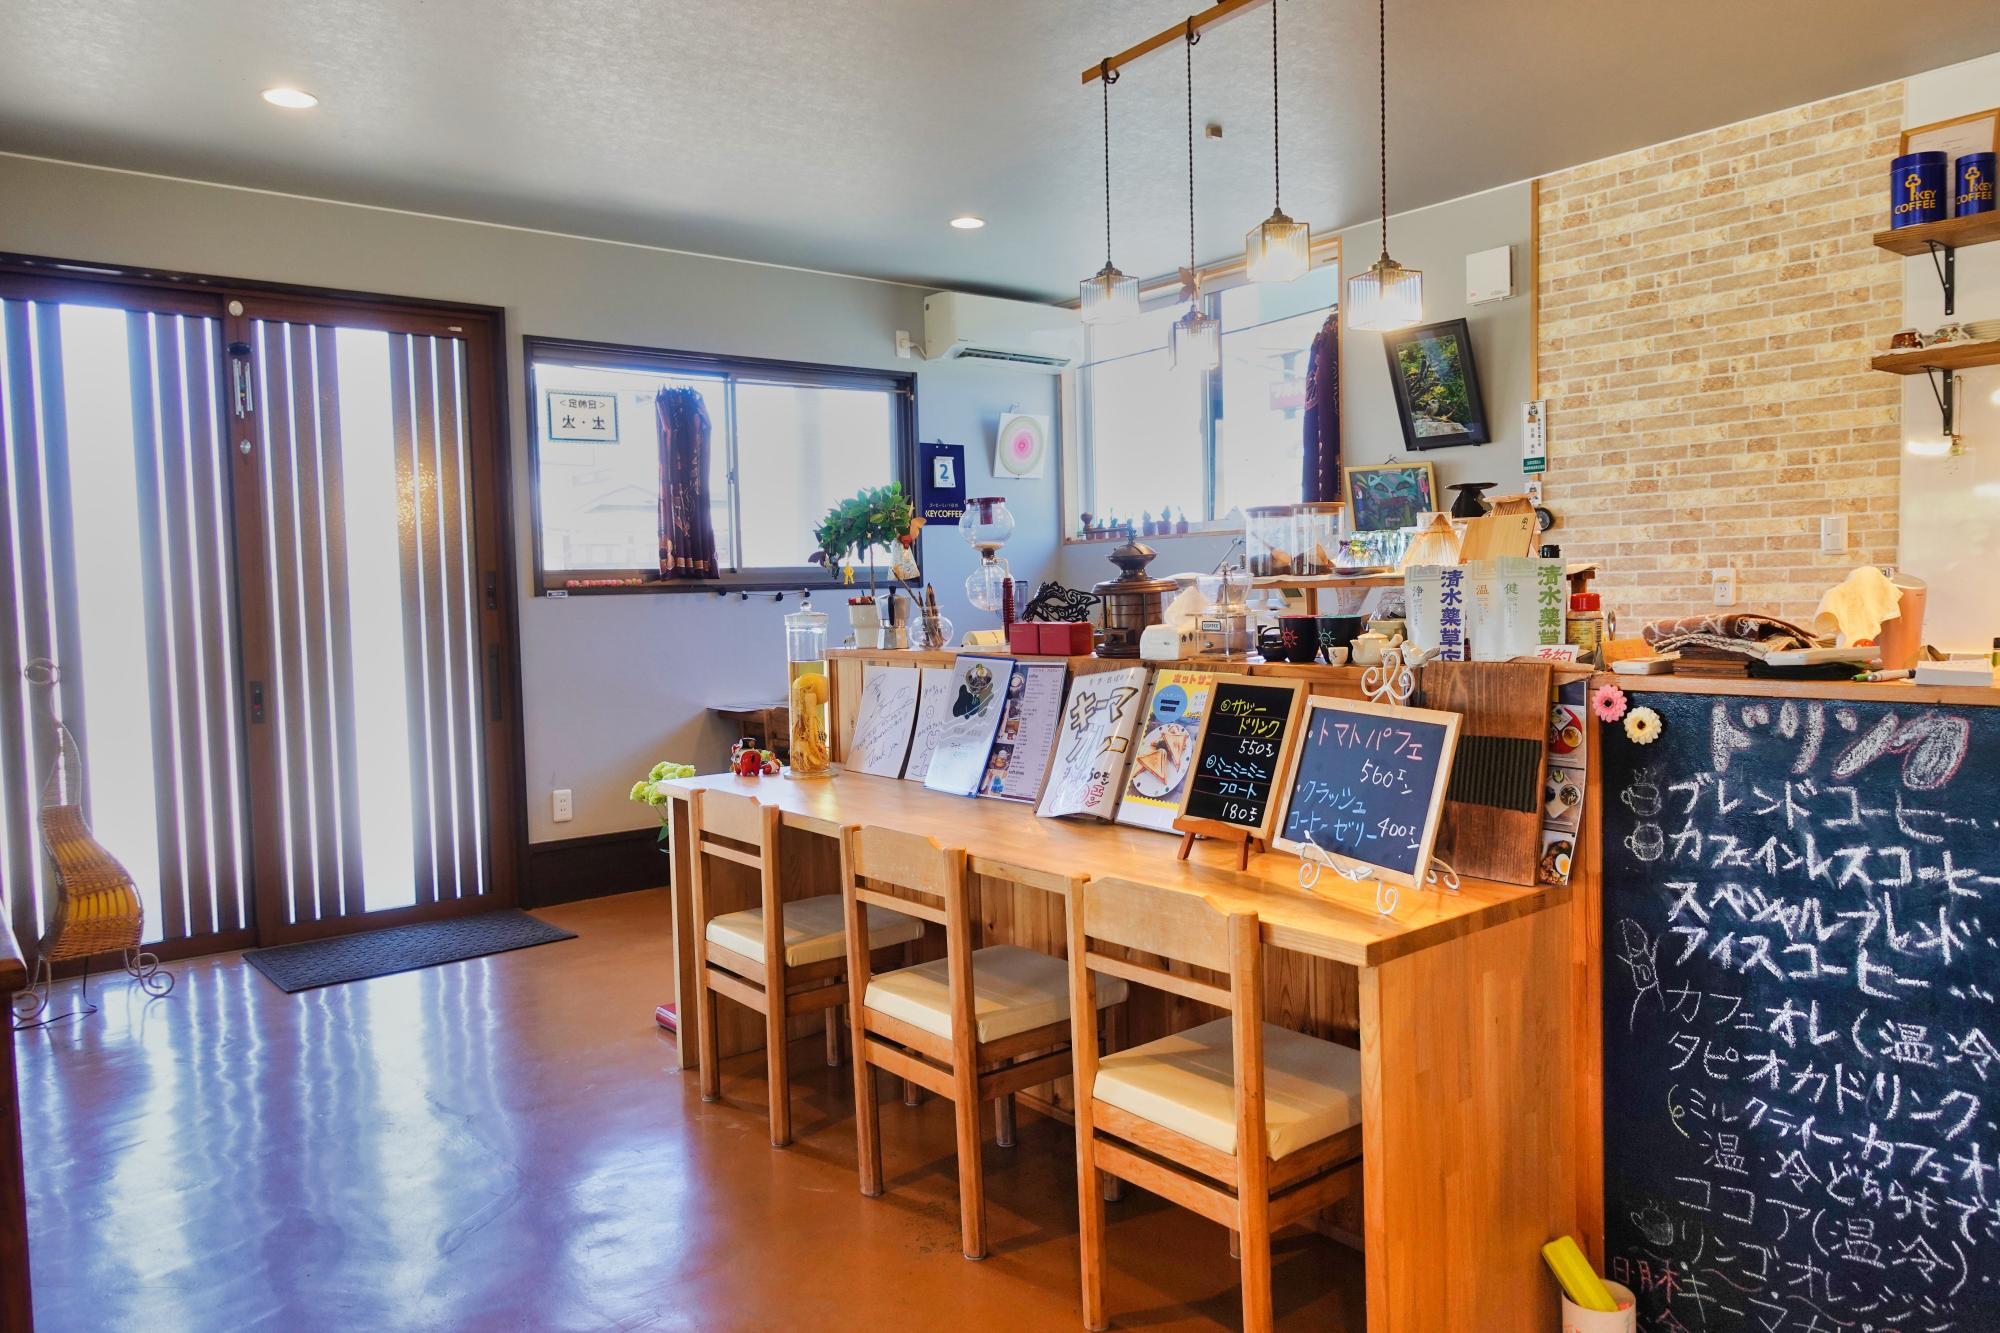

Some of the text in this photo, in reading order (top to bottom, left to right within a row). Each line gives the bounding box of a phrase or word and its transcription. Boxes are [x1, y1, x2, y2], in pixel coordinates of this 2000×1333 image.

[1914, 189, 1937, 200] KEY
[1956, 191, 1993, 205] COFFEE
[1895, 199, 1936, 215] COFFEE
[939, 463, 950, 481] 2
[1475, 584, 1489, 596] 温
[1710, 700, 1971, 791] ドリンク
